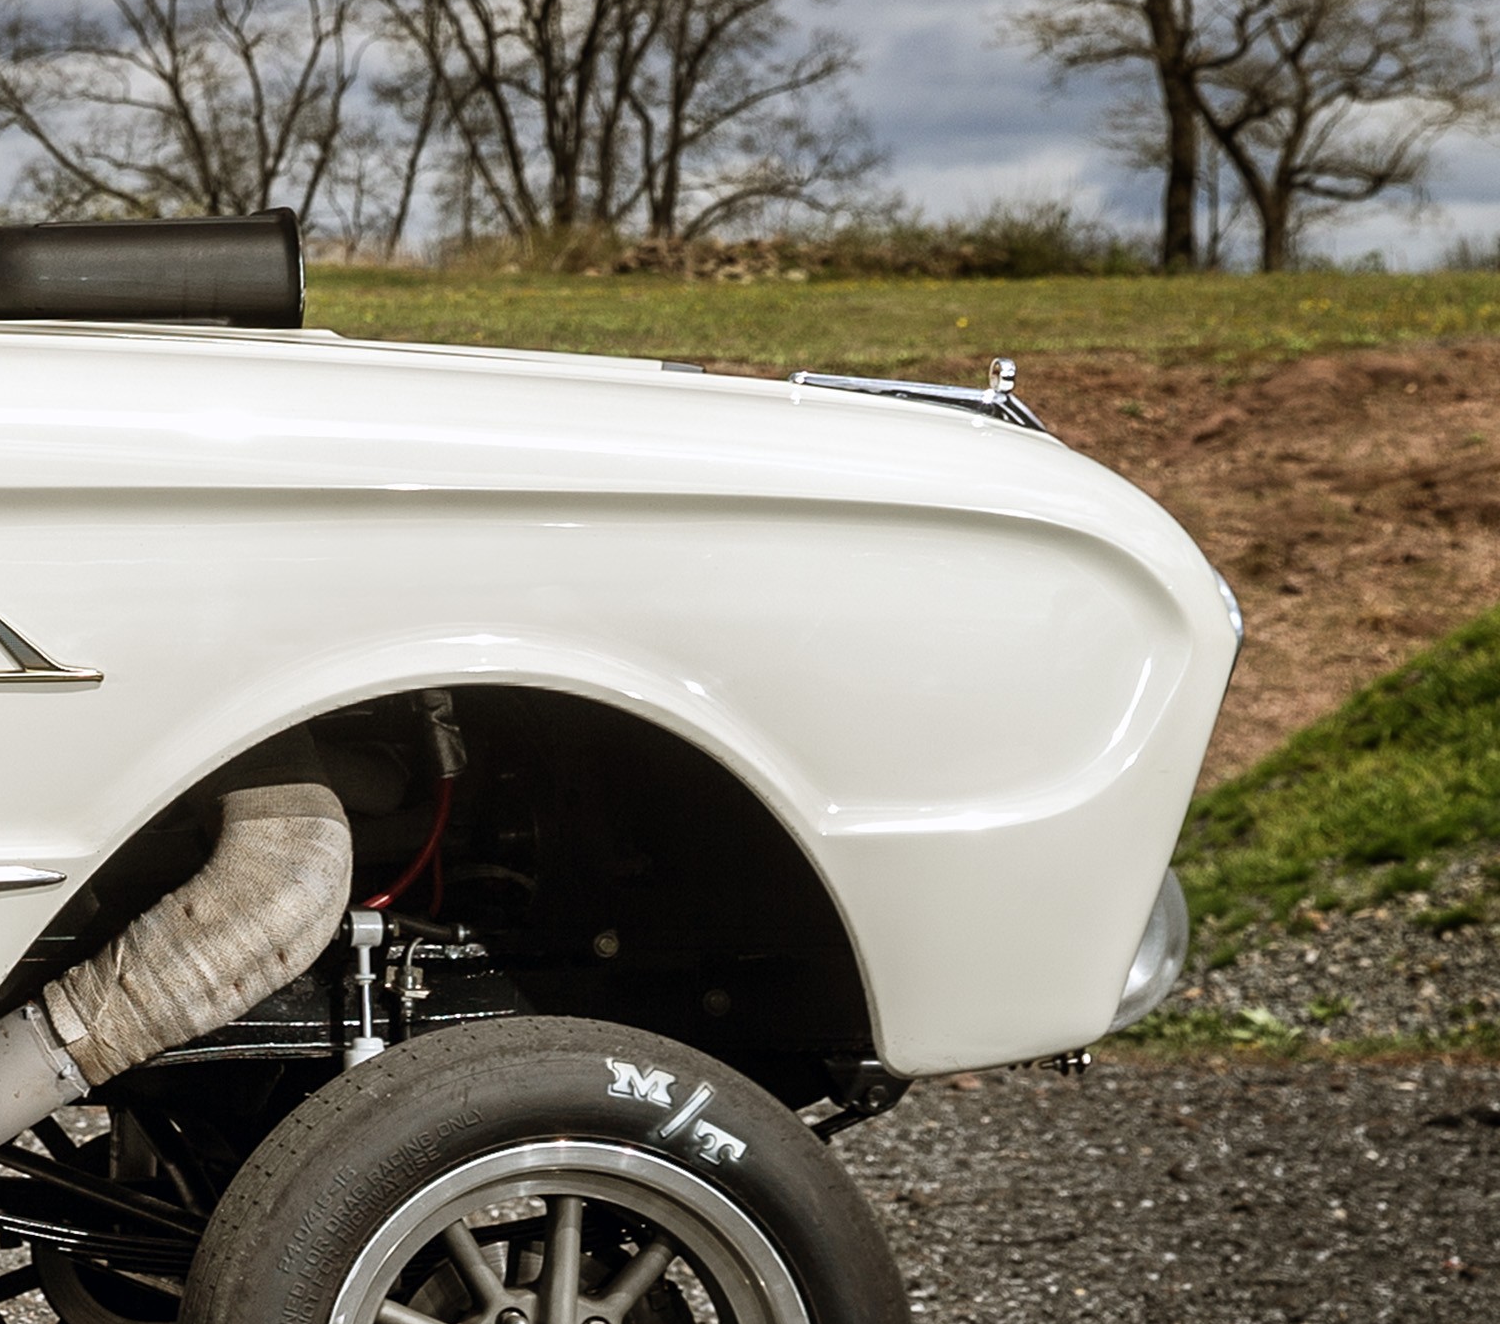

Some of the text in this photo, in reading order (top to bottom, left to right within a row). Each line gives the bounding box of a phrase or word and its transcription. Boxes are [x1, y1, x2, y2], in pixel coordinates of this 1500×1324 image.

[299, 1235, 330, 1280] FOR
[324, 1186, 368, 1236] DRAG
[370, 1131, 434, 1186] RACING
[436, 1109, 486, 1139] ONLY
[312, 1247, 342, 1288] FOR
[339, 1176, 402, 1243] HIGHWAY
[401, 1145, 442, 1176] USE
